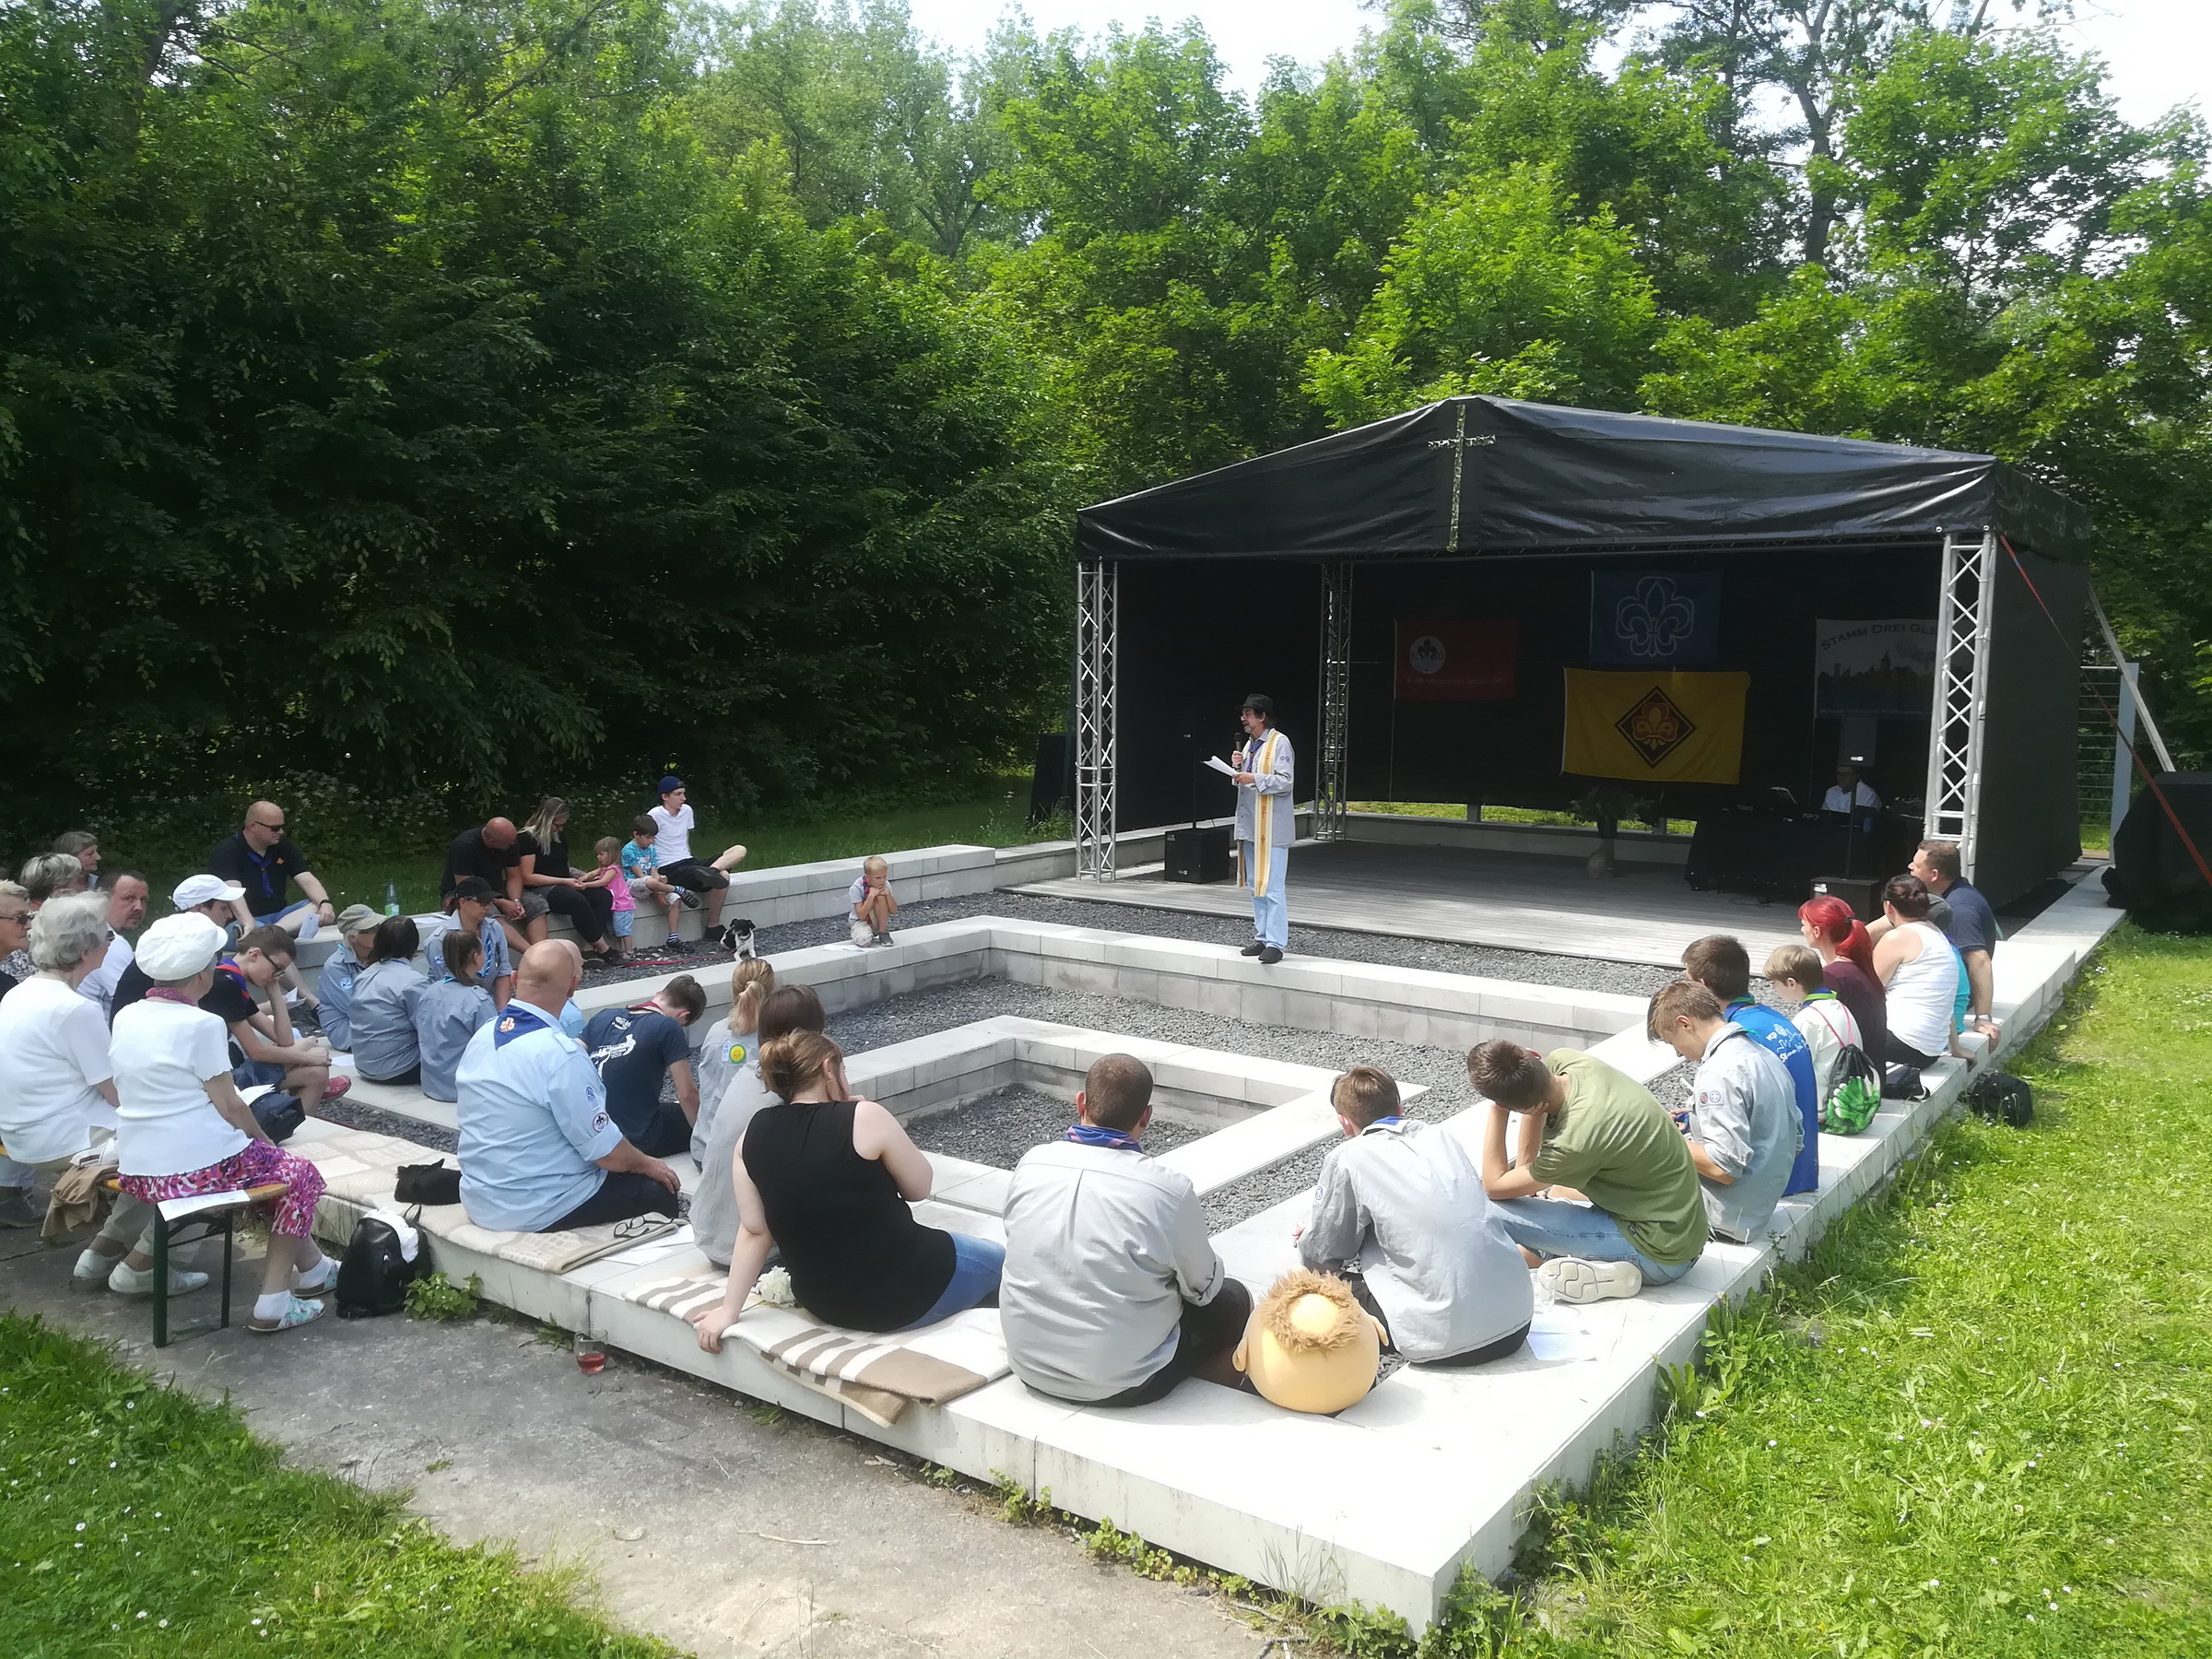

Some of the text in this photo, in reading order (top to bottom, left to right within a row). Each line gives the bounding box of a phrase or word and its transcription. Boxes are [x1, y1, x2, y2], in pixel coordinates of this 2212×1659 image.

[1821, 623, 1937, 651] STAMM DREI GLE
